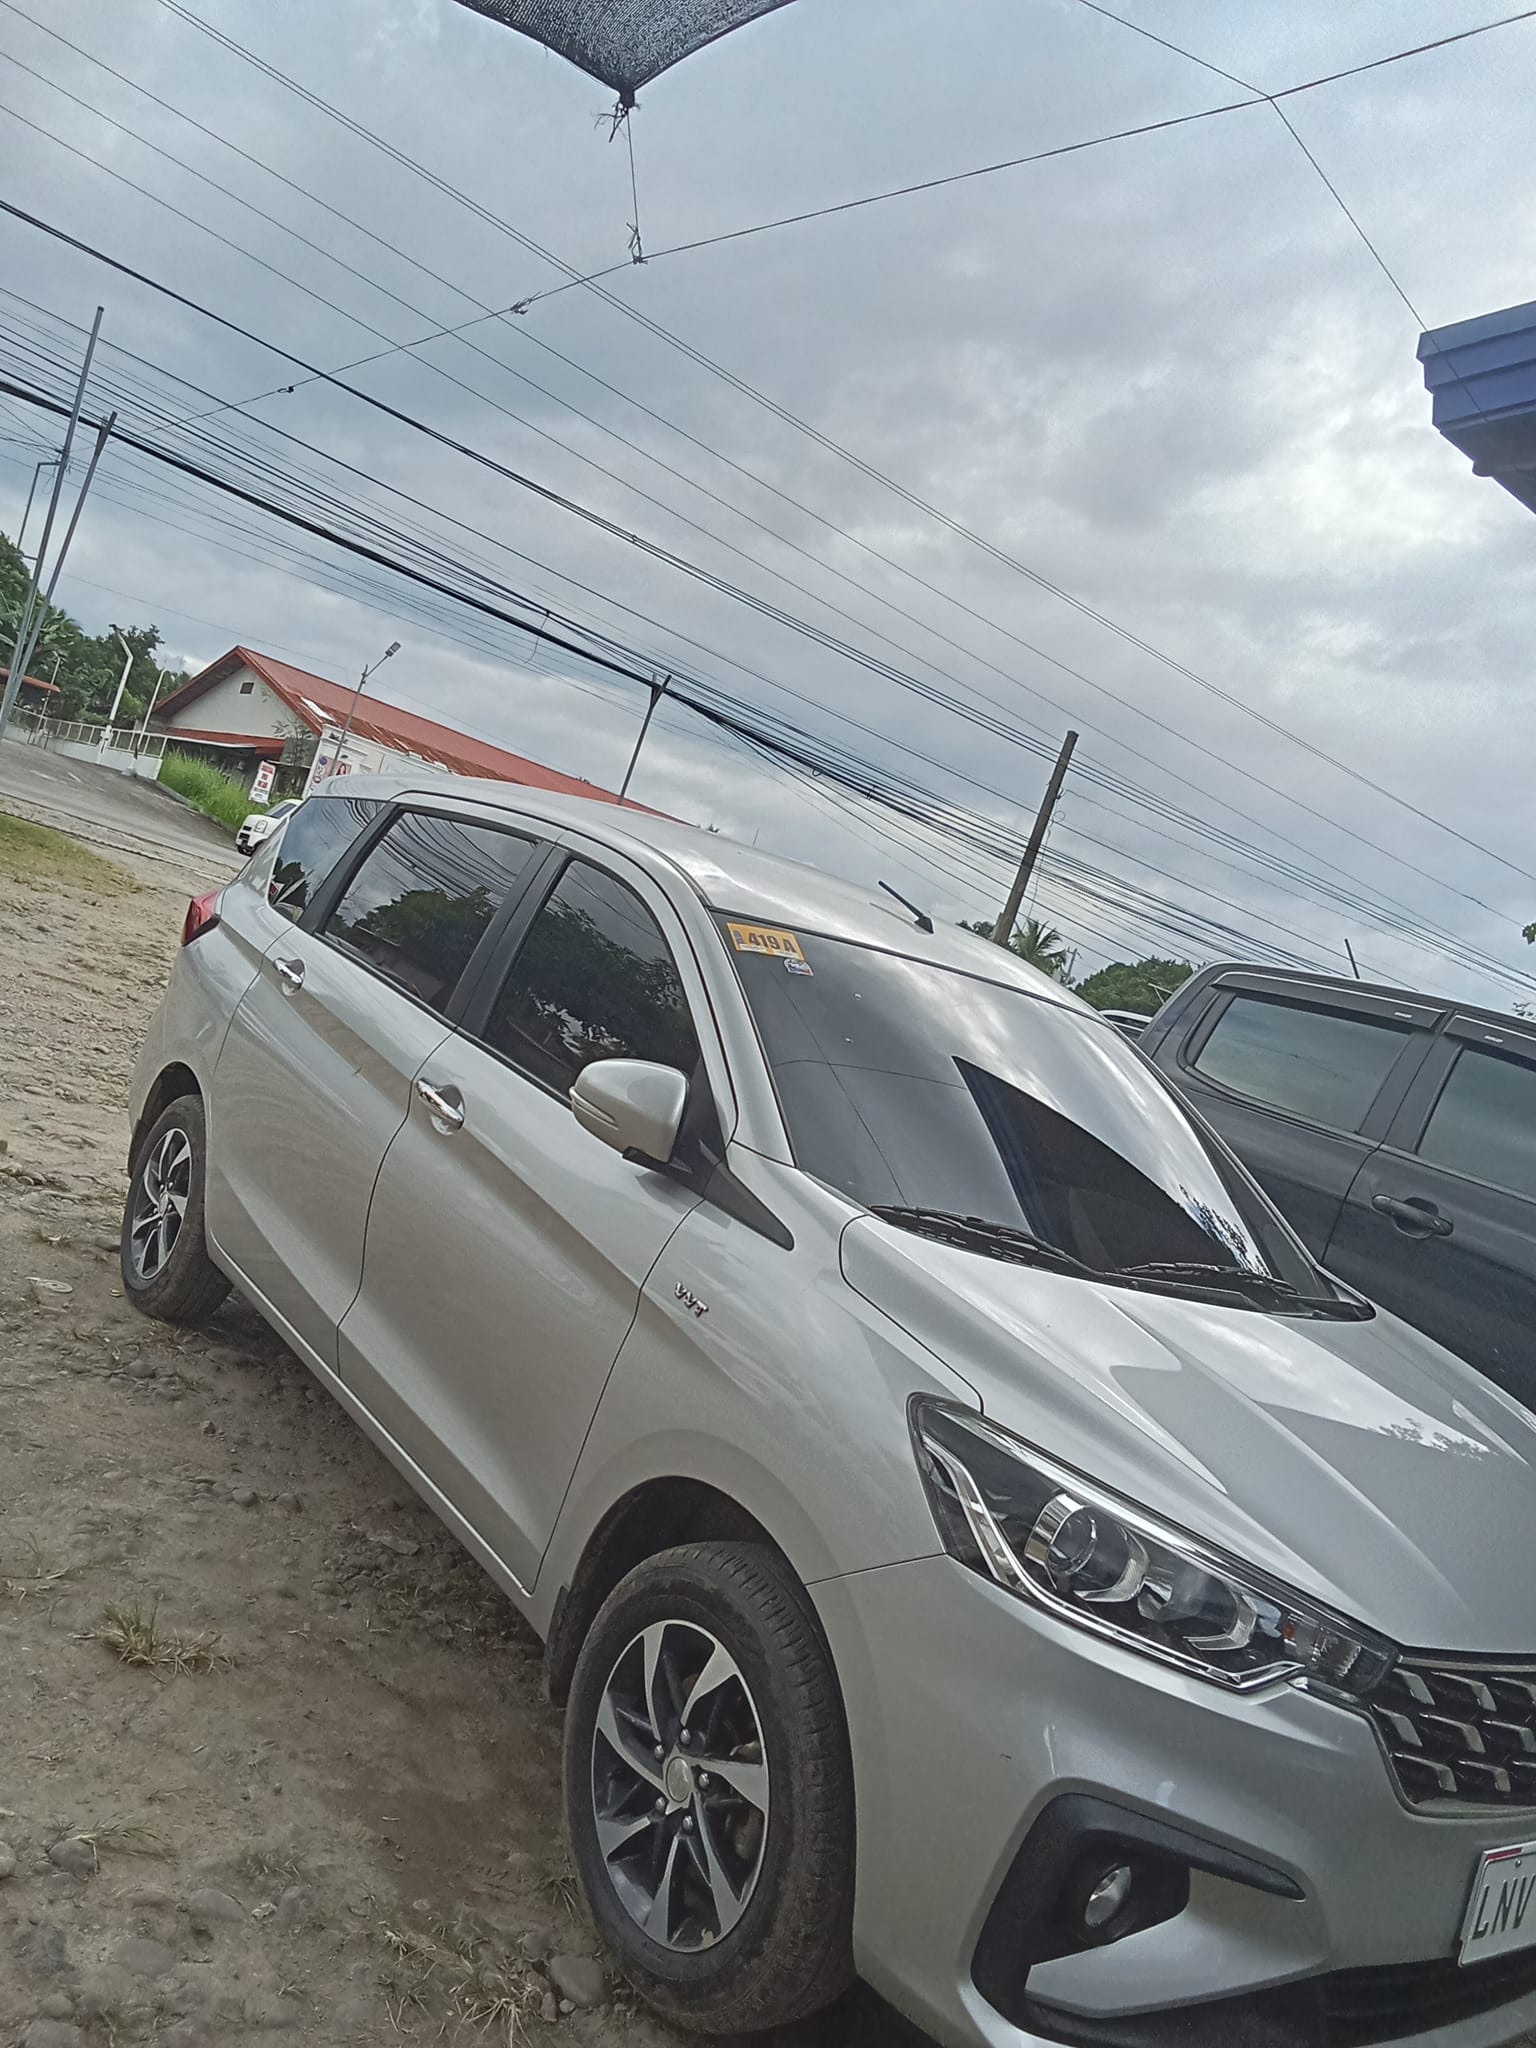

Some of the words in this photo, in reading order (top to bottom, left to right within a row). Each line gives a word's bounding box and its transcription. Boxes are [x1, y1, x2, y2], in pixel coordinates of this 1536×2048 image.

[748, 932, 780, 949] 419
[783, 938, 797, 953] A
[1471, 1873, 1536, 1940] LNV
